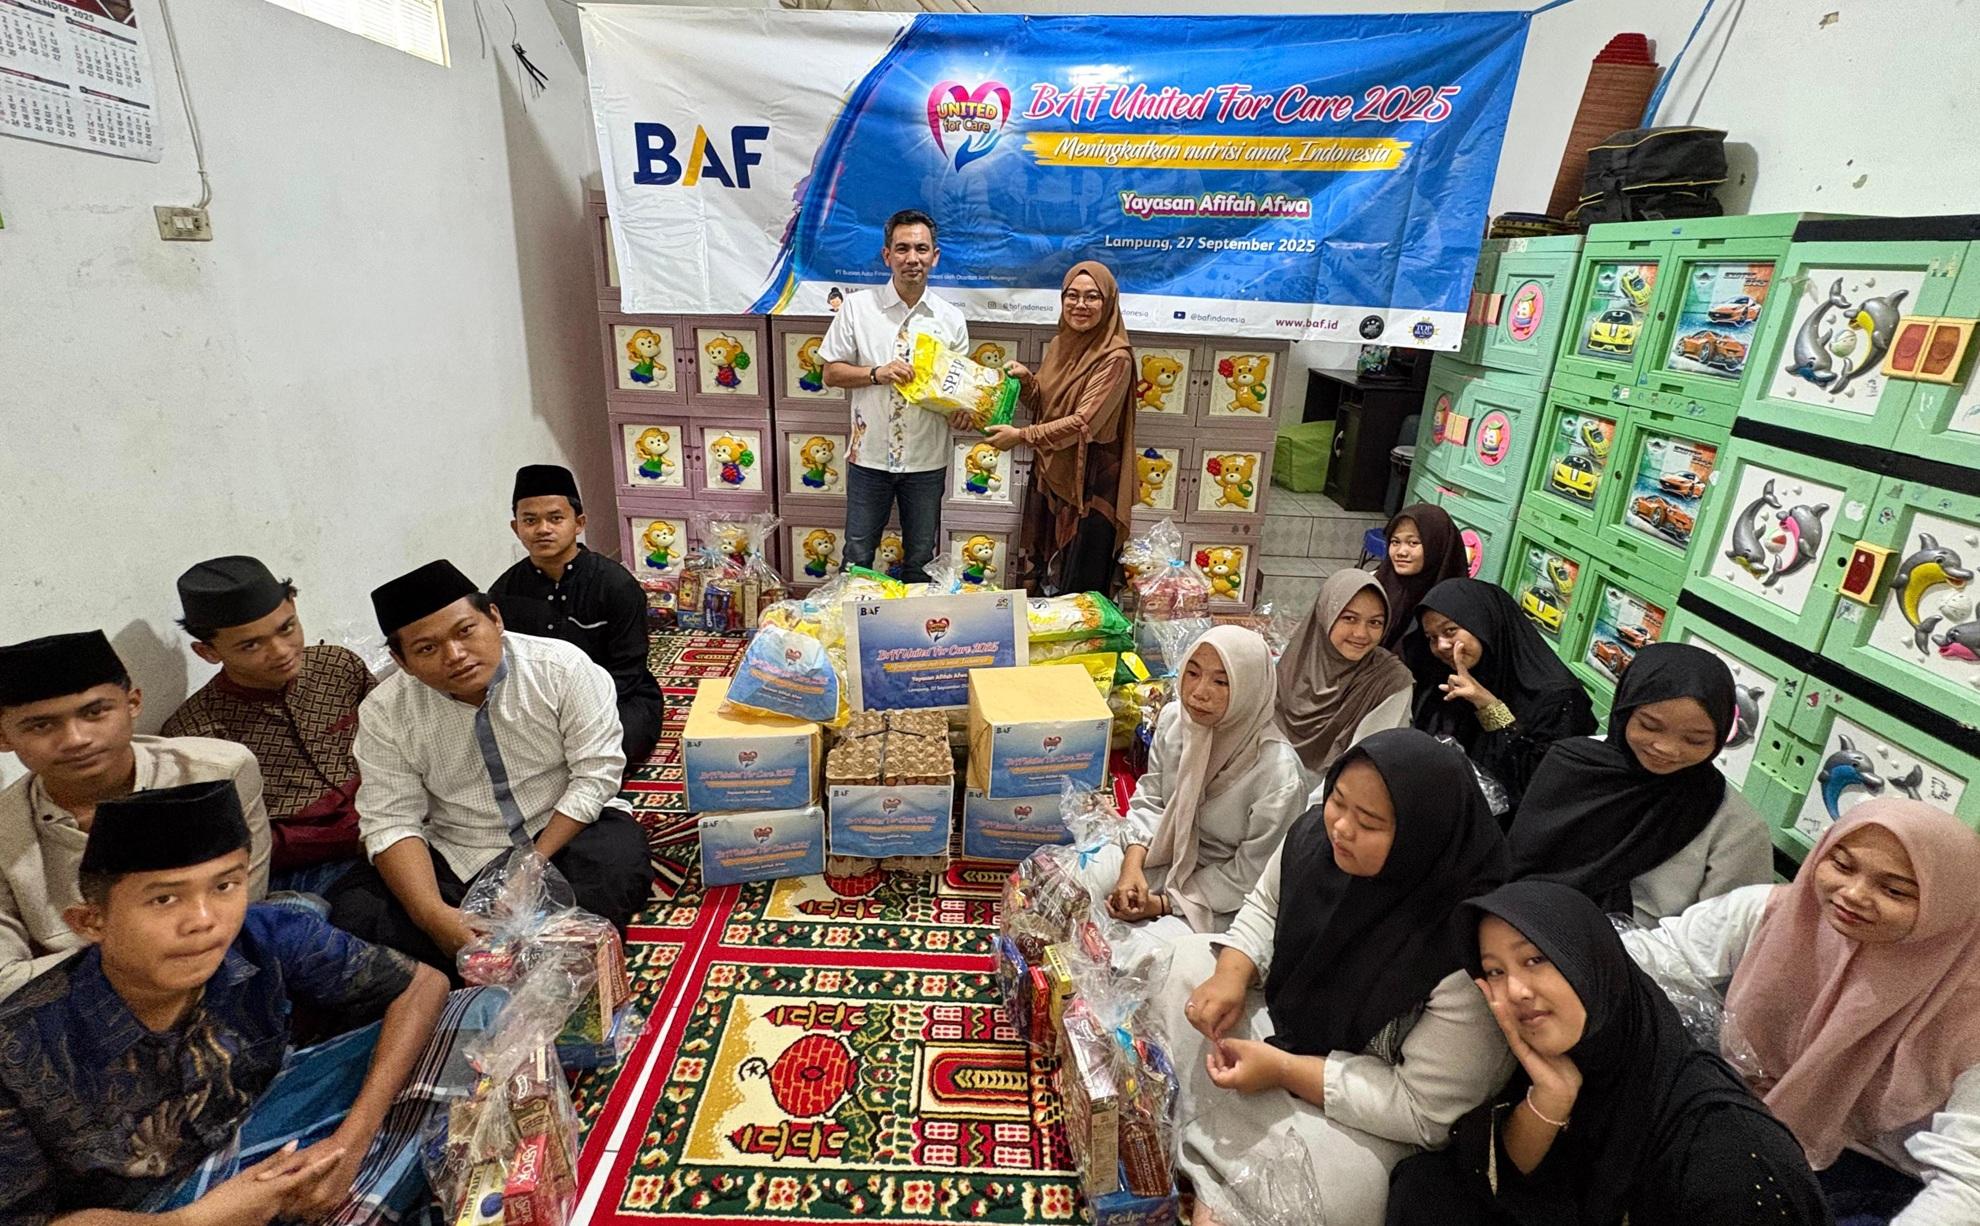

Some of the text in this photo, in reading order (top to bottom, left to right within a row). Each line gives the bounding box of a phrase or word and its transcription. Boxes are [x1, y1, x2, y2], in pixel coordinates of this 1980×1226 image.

[936, 101, 998, 120] UNITED
[1022, 83, 1461, 124] BAF United For Care 2025
[943, 118, 991, 133] for Care
[633, 122, 770, 189] BAF
[1054, 136, 1393, 166] Meningkatkan nutrisi anak Indonesia
[1120, 192, 1311, 218] Yayasan Afifah Afwa
[1104, 235, 1316, 253] Lampung, 27 September 2025
[1190, 313, 1246, 324] @bafindonesia
[1275, 318, 1338, 330] www.baf.id
[860, 606, 880, 616] BAF
